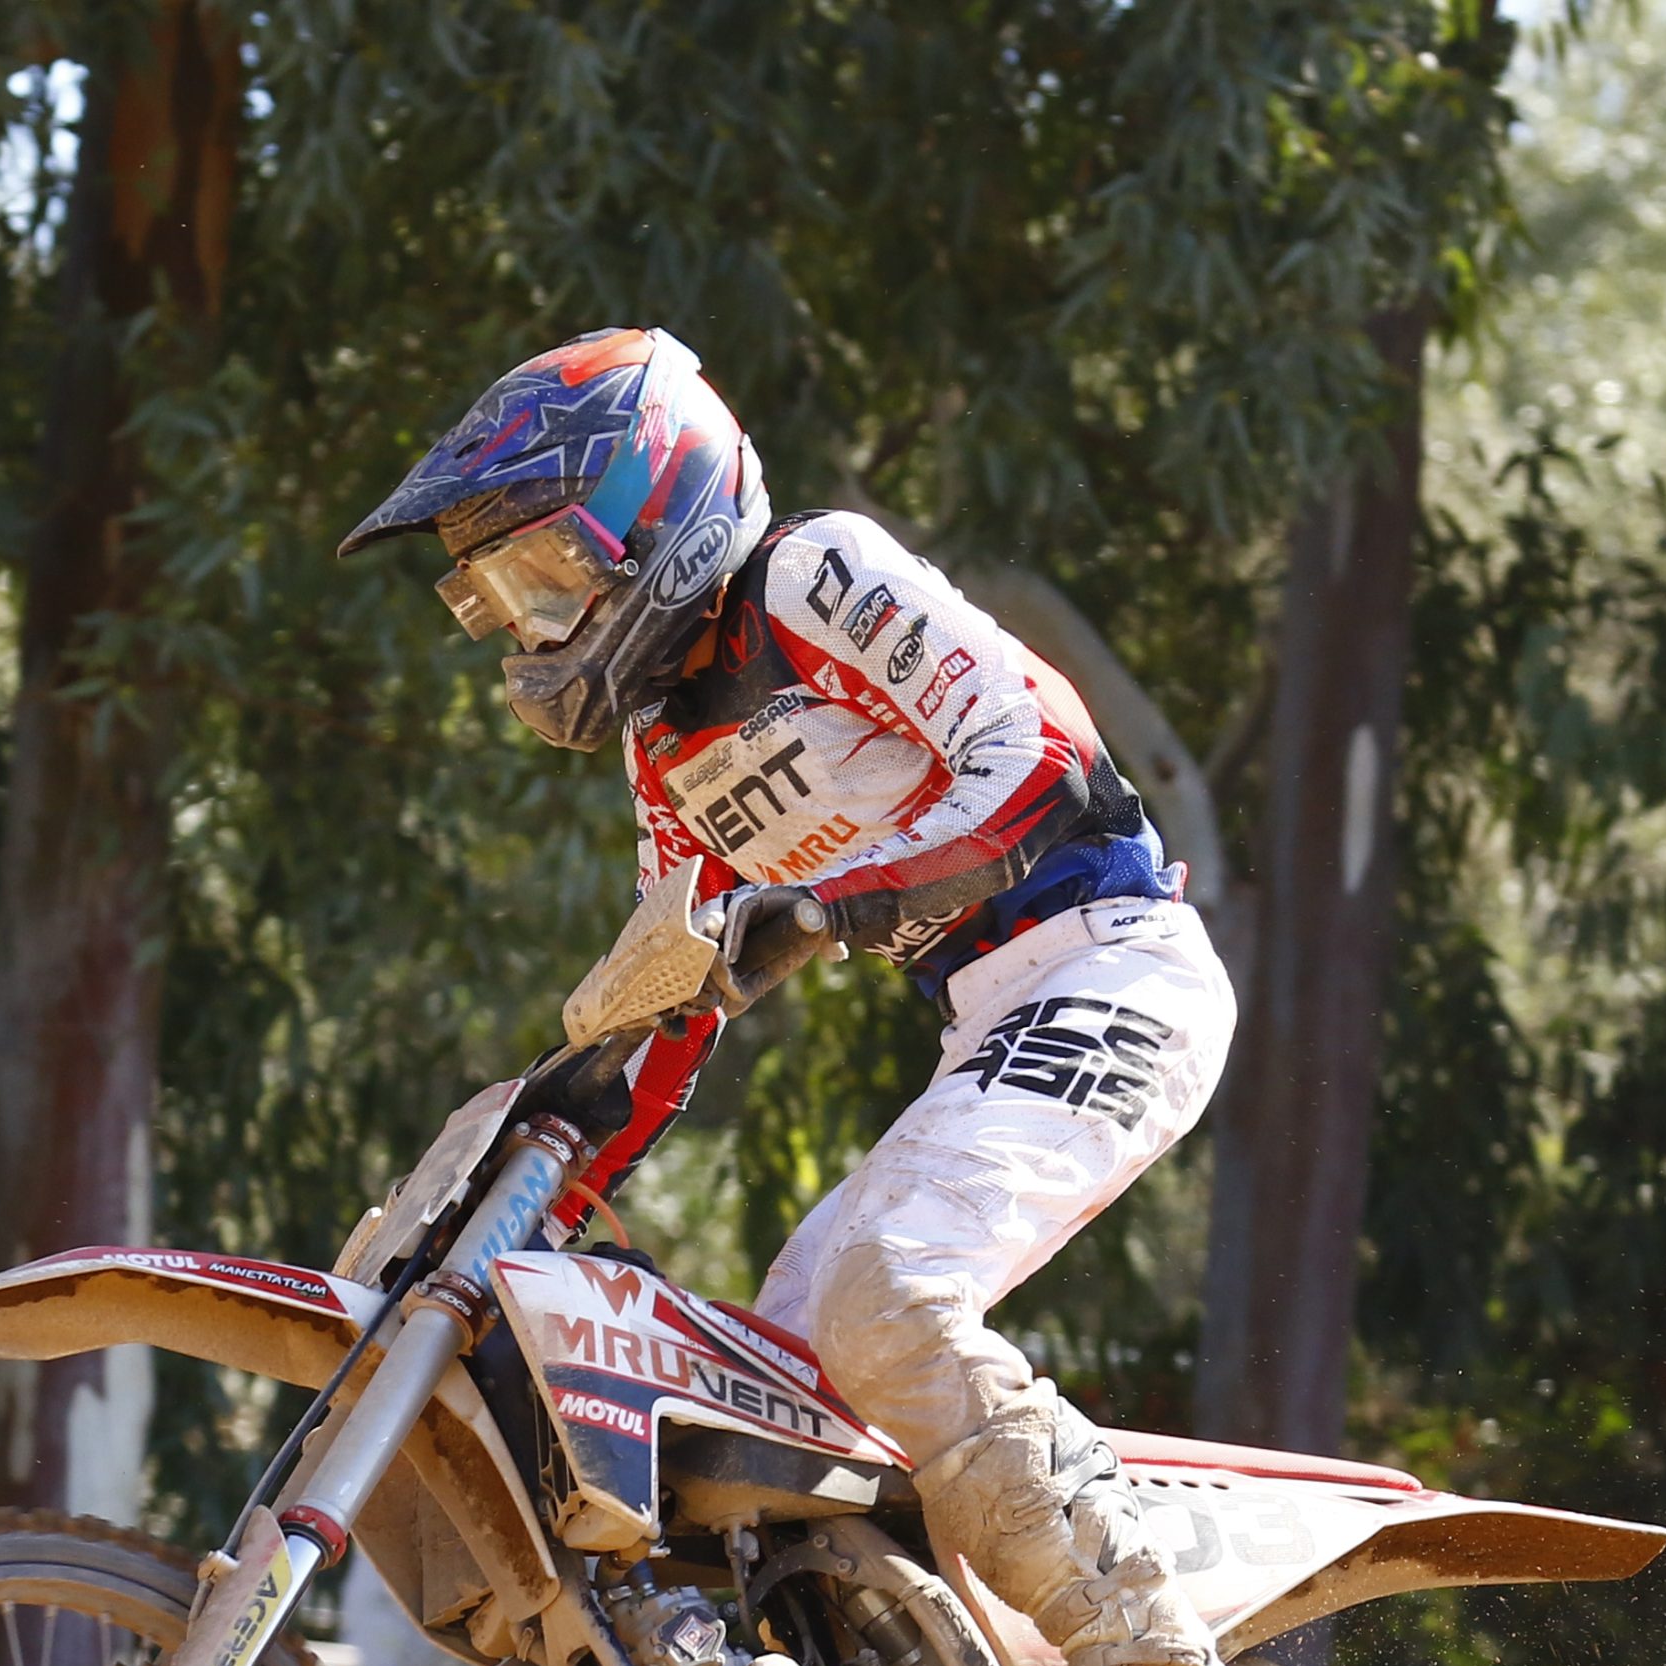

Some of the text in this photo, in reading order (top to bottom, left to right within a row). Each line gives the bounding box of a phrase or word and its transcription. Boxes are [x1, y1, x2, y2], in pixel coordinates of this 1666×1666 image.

[664, 523, 725, 603] Arai
[920, 653, 971, 717] MOTUL
[778, 813, 861, 880] MRU
[101, 1253, 201, 1270] MOTUL
[558, 1393, 646, 1437] MOTUL
